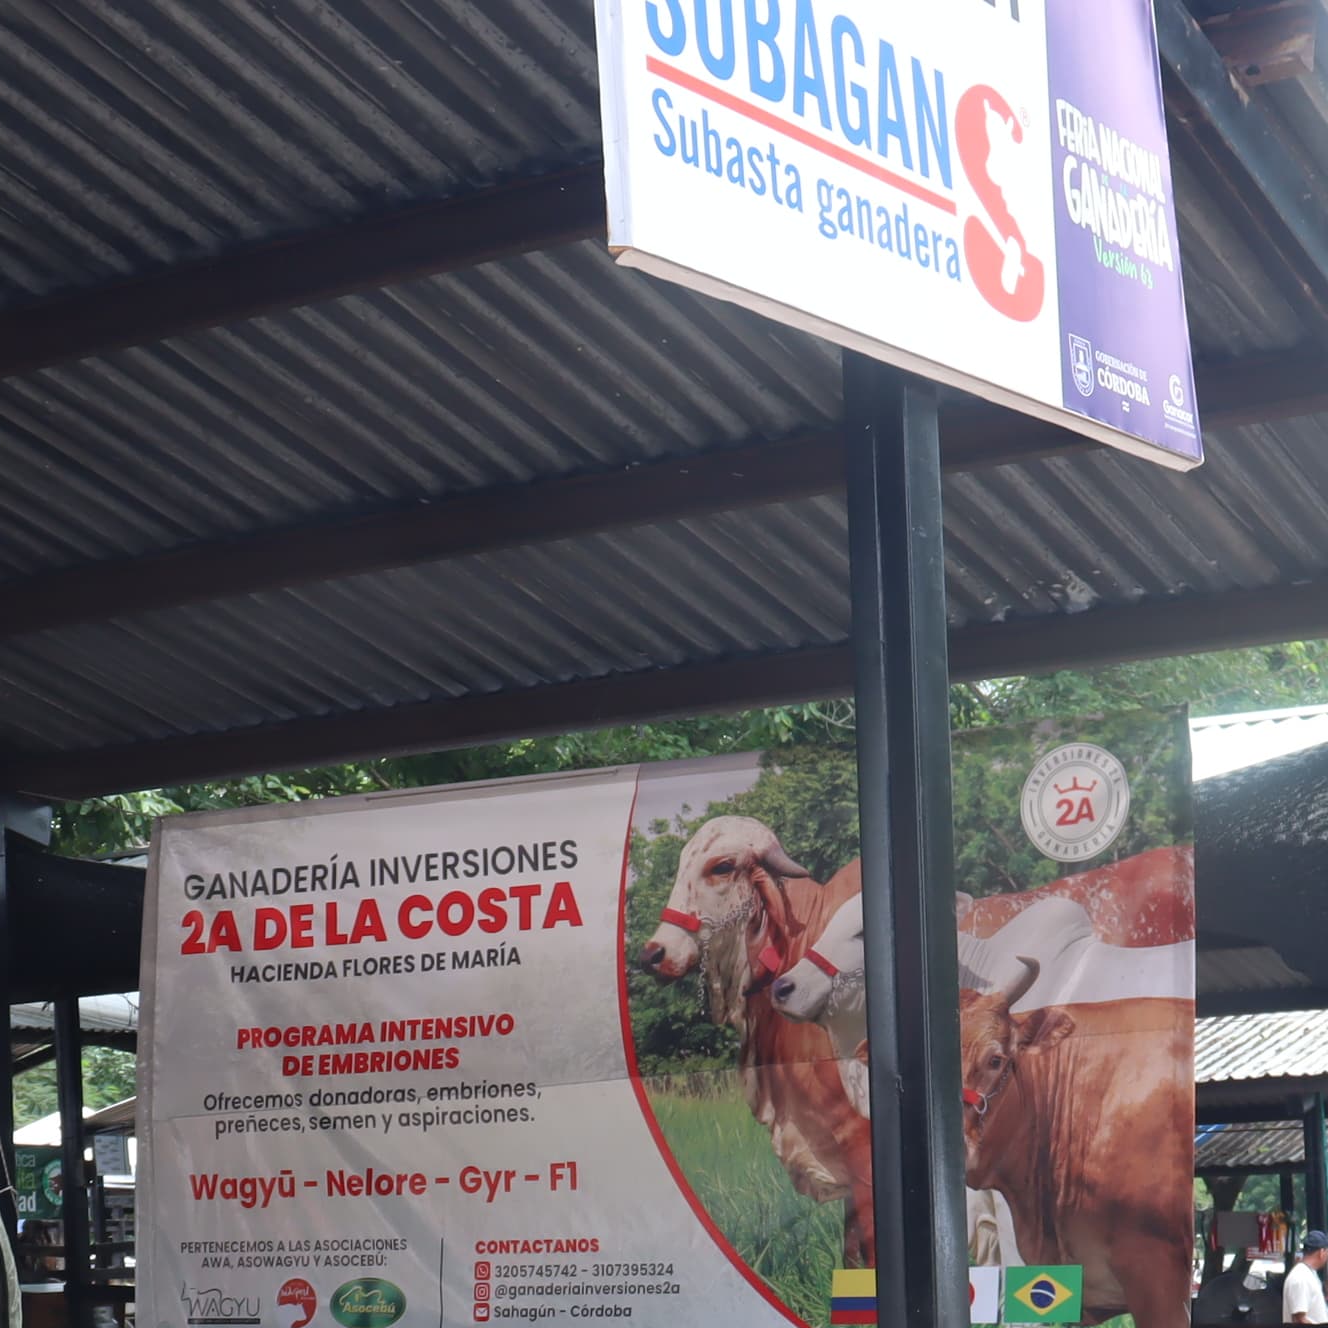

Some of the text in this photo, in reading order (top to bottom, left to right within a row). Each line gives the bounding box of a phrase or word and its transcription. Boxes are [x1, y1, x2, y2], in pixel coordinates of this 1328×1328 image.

[651, 87, 962, 282] Subasta ganadera
[1097, 366, 1151, 406] CÓRDOBA
[1055, 796, 1096, 826] 2A
[184, 840, 578, 900] GANADERÍA INVERSIONES
[180, 881, 583, 955] 2A DE LA COSTA
[231, 941, 521, 984] HACIENDA FLORES DE MARÍA
[237, 1013, 514, 1050] PROGRAMA INTENSIVO
[282, 1047, 460, 1076] DE EMBRIONES
[203, 1080, 542, 1111] Ofrecemos donadoras, embriones,
[215, 1105, 535, 1140] preñeces, semen y aspiraciones.
[189, 1169, 296, 1209] Wagyū
[326, 1168, 427, 1197] Nelore
[459, 1165, 516, 1204] Gyr
[550, 1161, 577, 1191] F1
[180, 1238, 407, 1254] PERTENECEMOS A LAS ASOCIACIONES
[201, 1252, 388, 1269] AWA, ASOWAGYU Y ASOCEBÚ:
[475, 1238, 600, 1254] CONTACTANOS
[494, 1264, 577, 1278] 3205745742
[592, 1263, 674, 1277] 3107395324
[494, 1281, 681, 1300] @ganaderiainversiones2a
[342, 1300, 396, 1314] Asocebú
[494, 1305, 556, 1321] Sahagún
[570, 1304, 632, 1318] Córdoba
